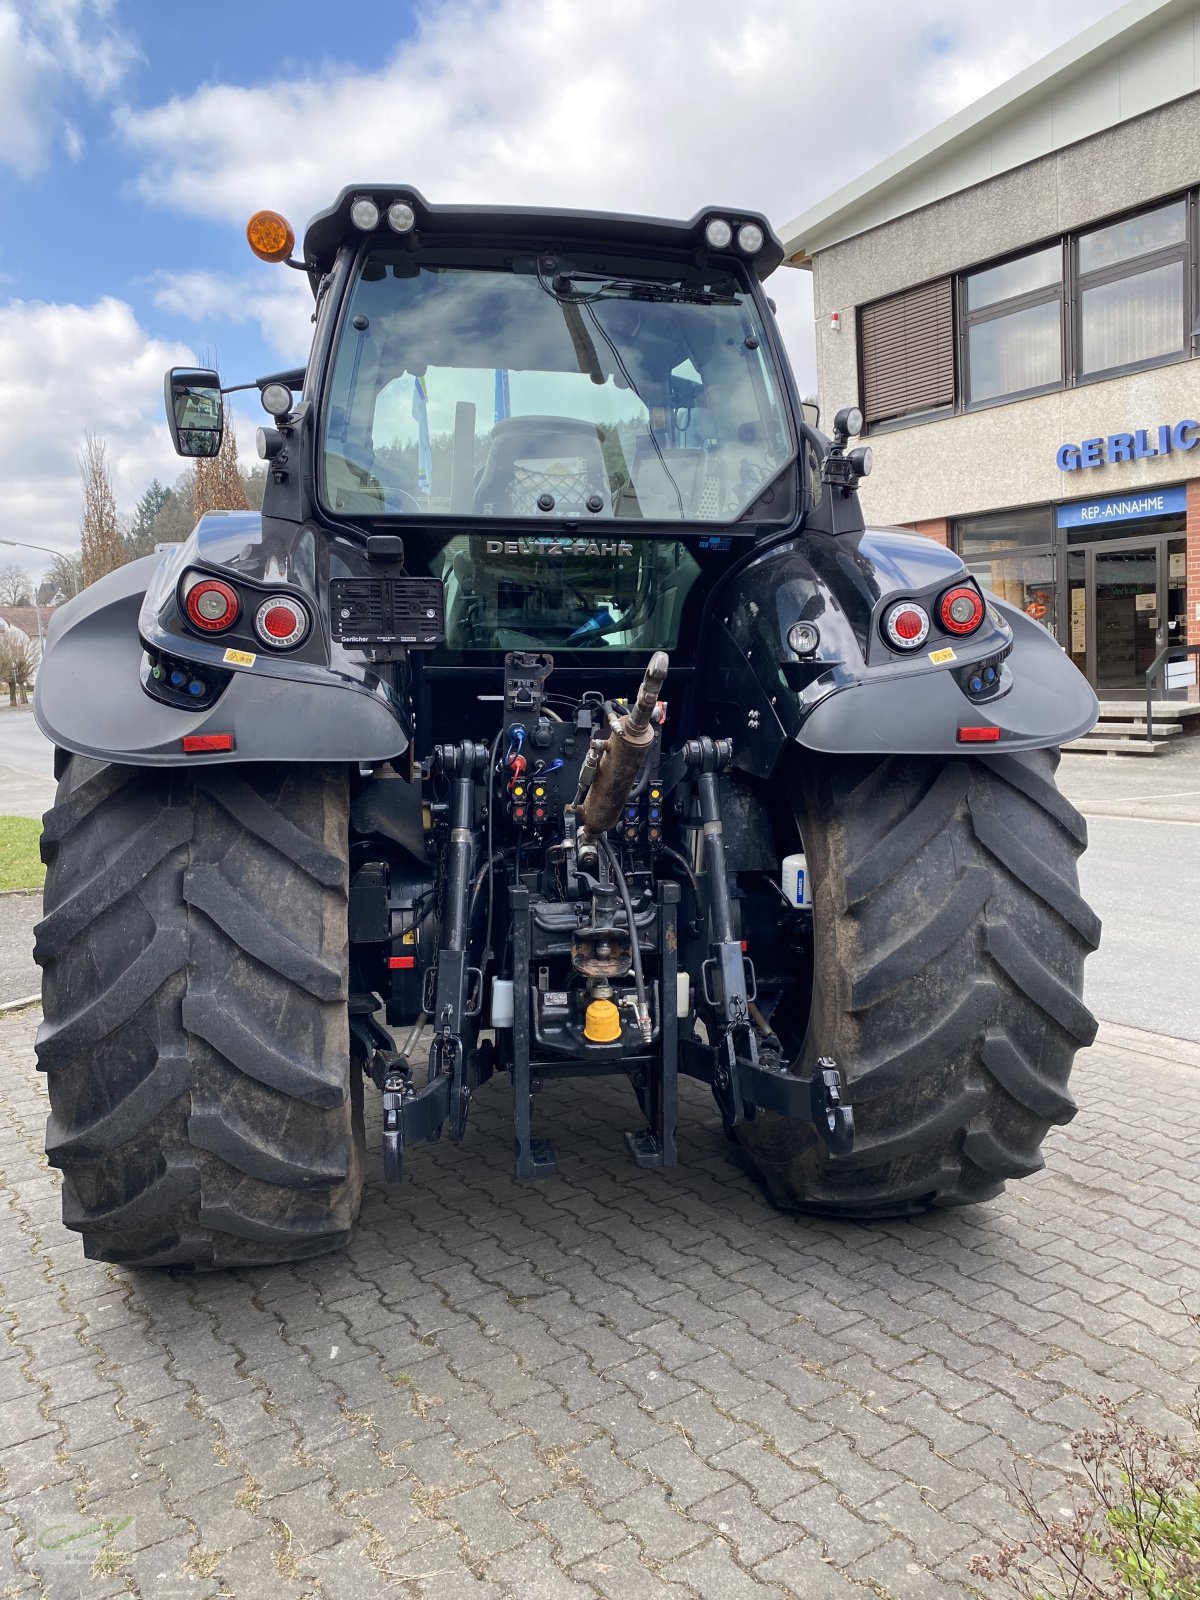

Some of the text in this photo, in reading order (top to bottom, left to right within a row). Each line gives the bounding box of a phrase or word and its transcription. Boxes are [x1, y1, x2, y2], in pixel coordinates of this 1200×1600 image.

[1056, 419, 1200, 472] GERLIC
[1081, 496, 1164, 520] REP.-ANNAHME
[486, 540, 633, 557] DEUTZ-FAHR
